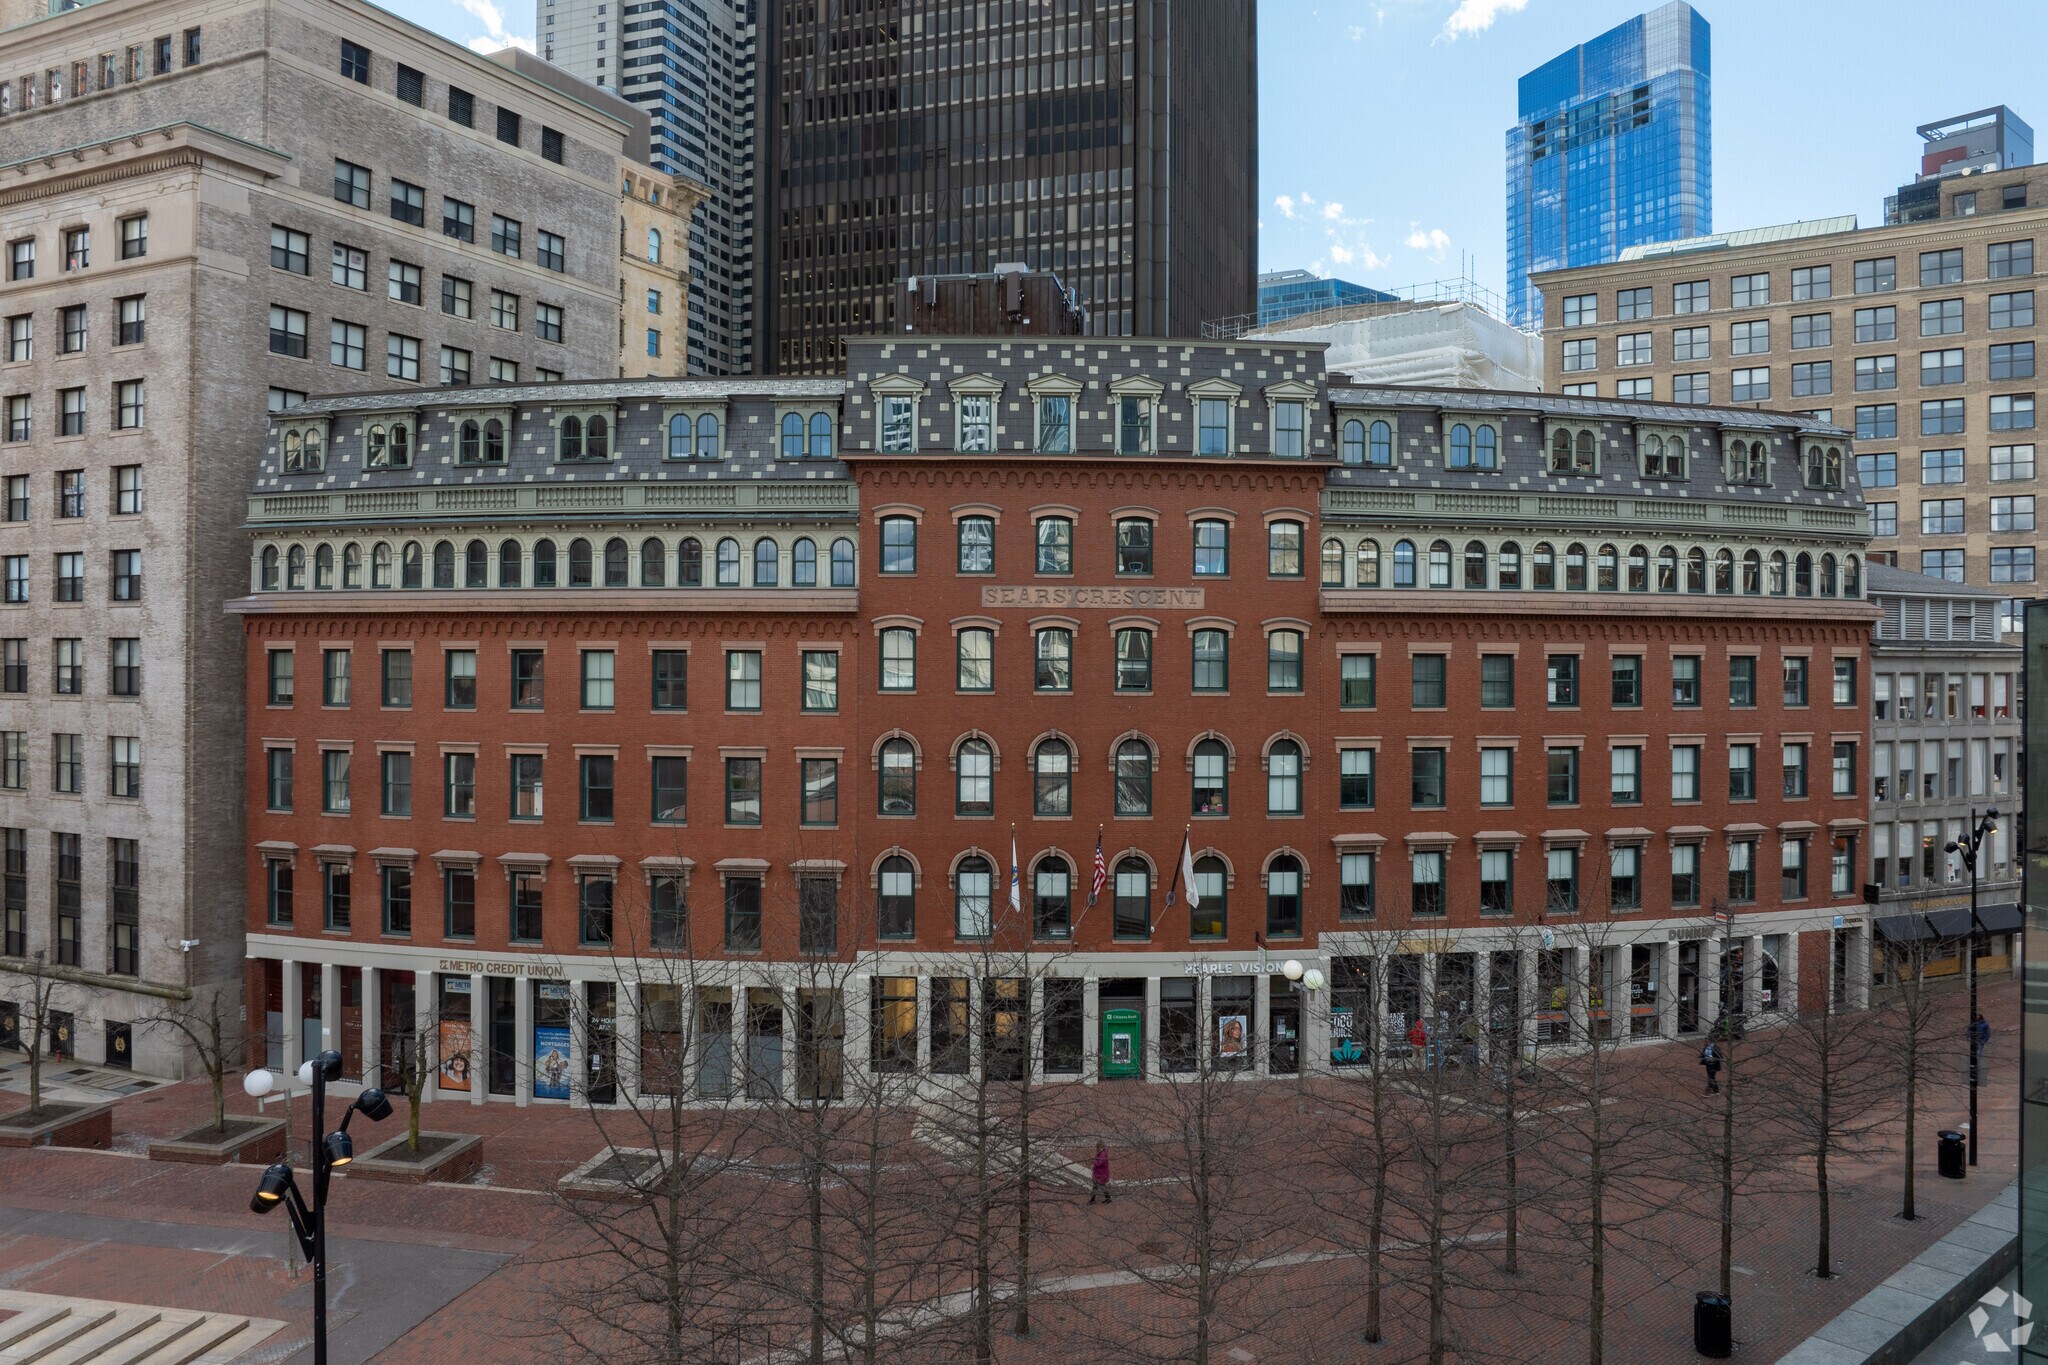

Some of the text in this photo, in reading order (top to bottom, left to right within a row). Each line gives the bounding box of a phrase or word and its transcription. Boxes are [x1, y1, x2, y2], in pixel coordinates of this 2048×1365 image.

[1074, 589, 1201, 605] CRESCENT
[450, 961, 562, 976] METRO CREDIT UNION
[1185, 962, 1285, 974] PEARLE VISION
